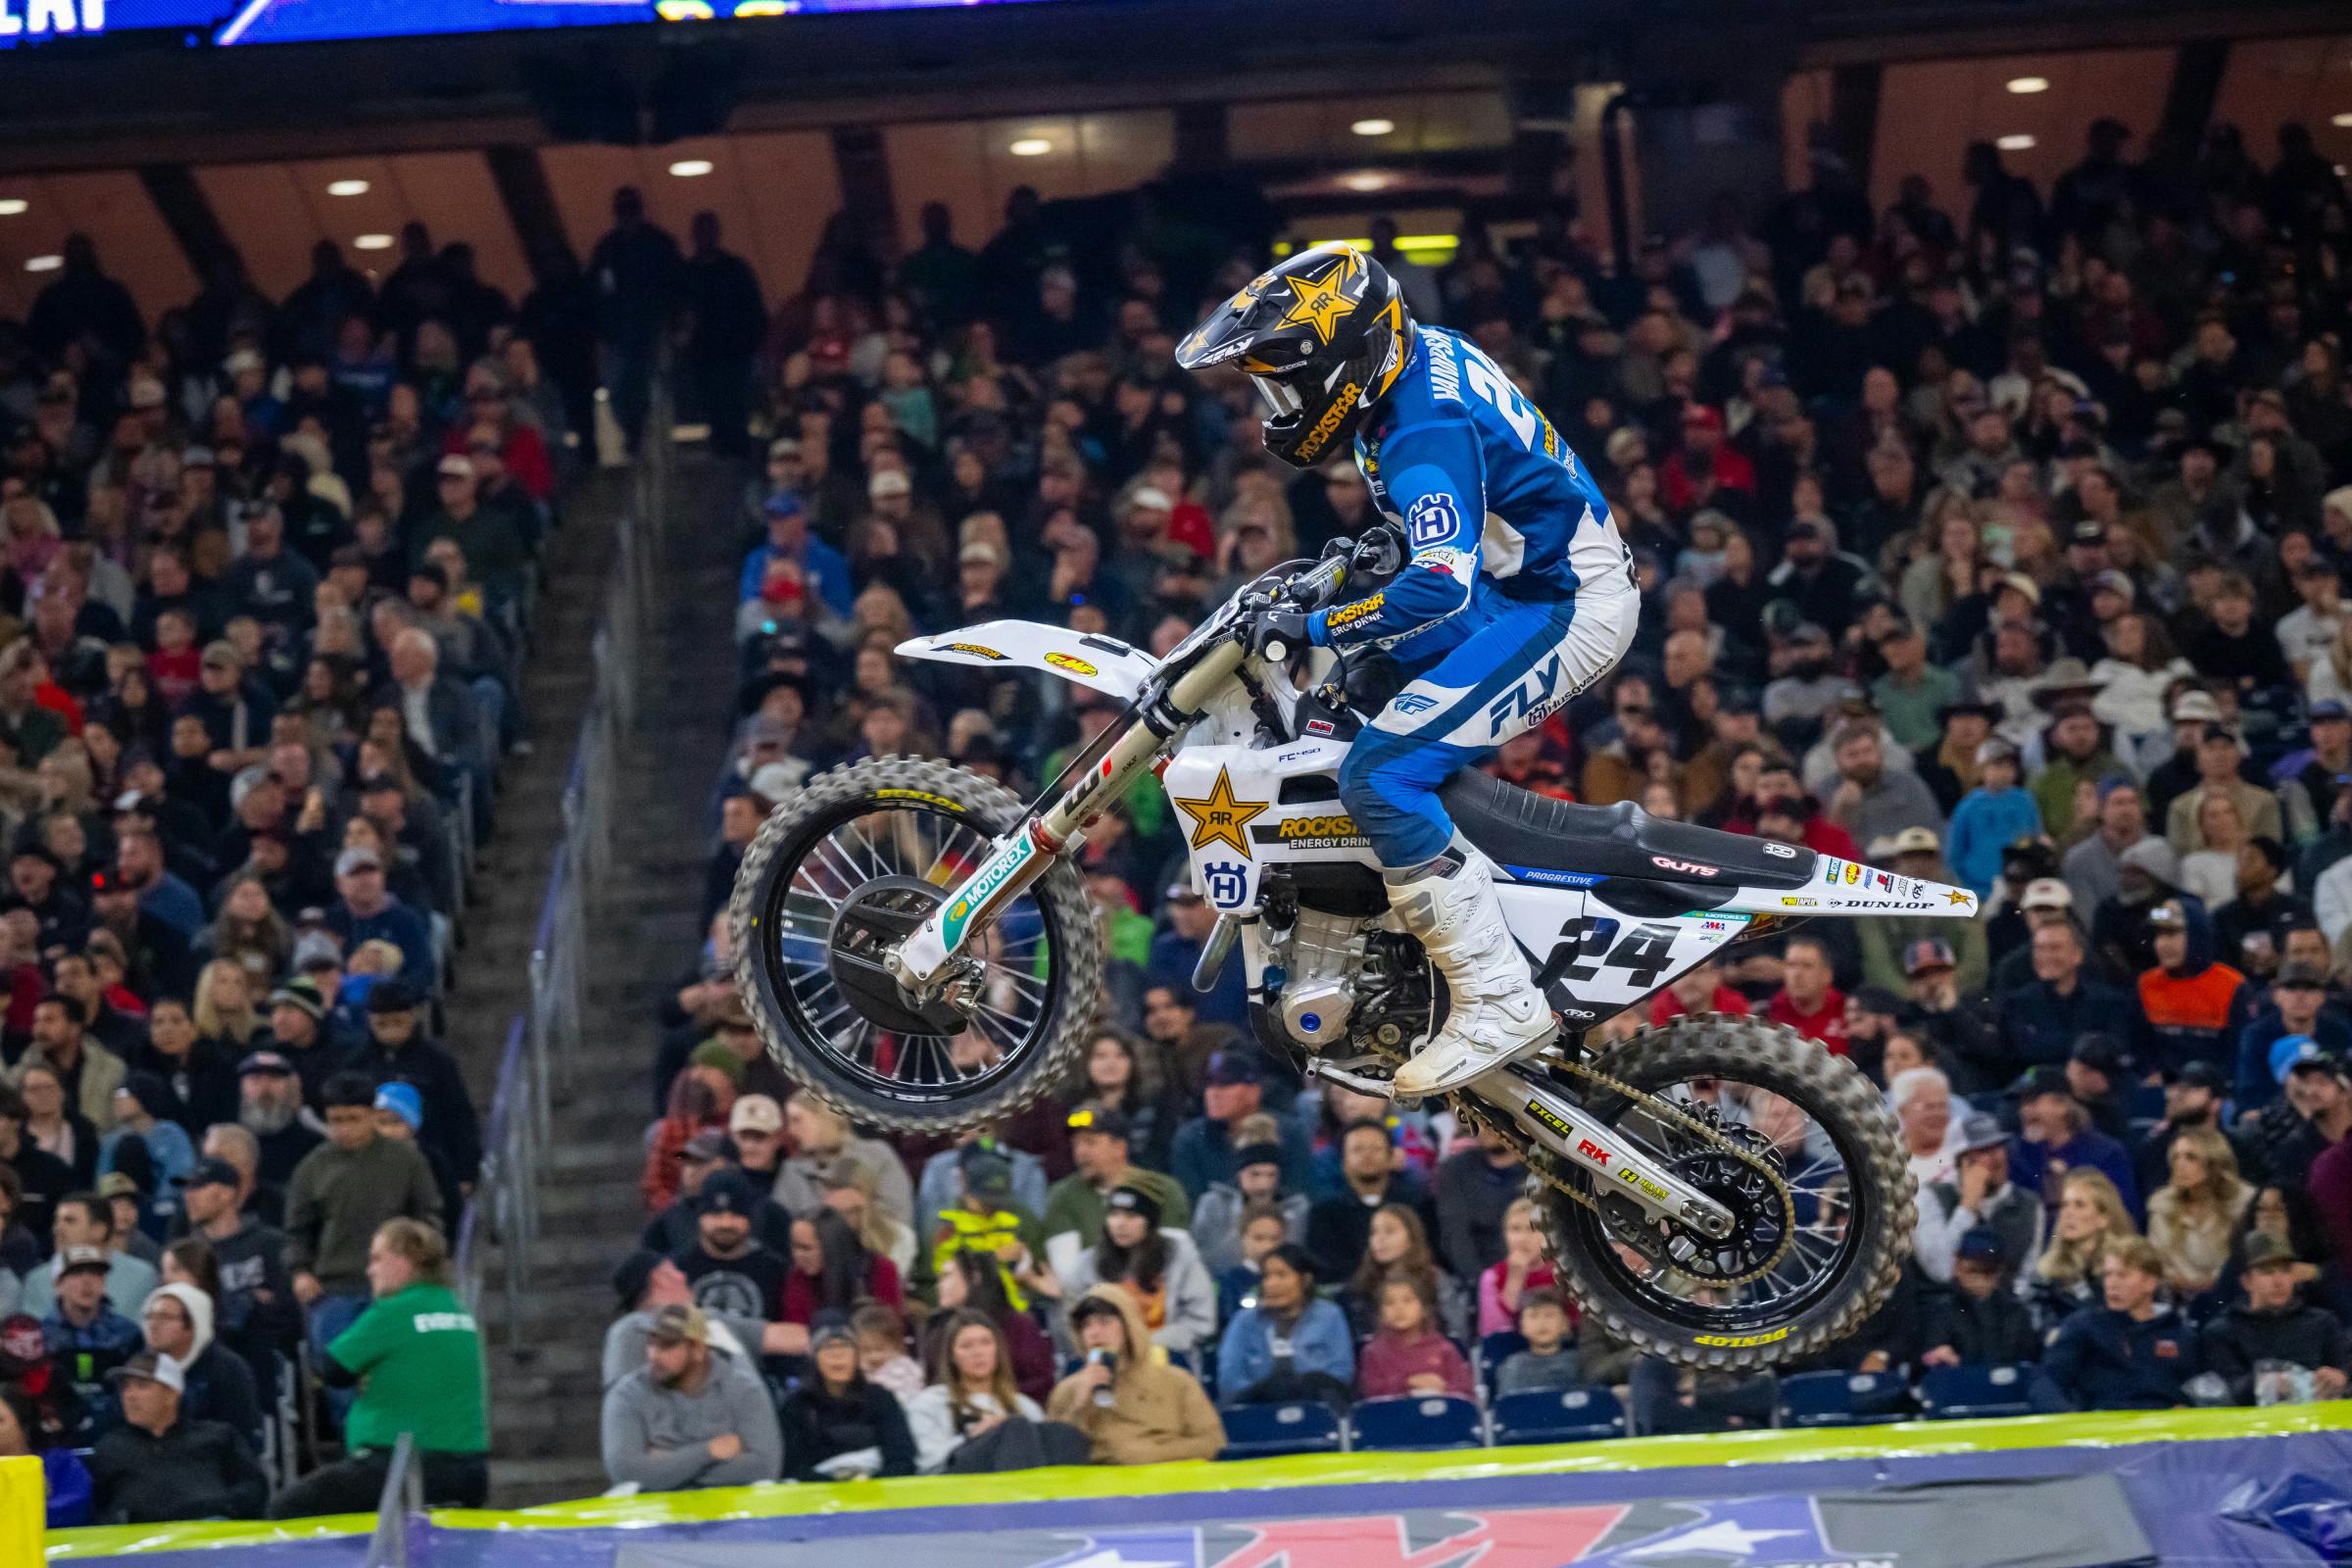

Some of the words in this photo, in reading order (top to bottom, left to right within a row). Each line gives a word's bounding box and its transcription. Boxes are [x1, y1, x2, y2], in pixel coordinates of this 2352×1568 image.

[1294, 382, 1362, 463] ROCKSTAR
[1353, 611, 1384, 629] DRINK
[1490, 654, 1560, 739] FLY
[1290, 838, 1339, 849] ENERGY
[1340, 836, 1372, 847] DRIN
[964, 842, 1028, 906] MOTOREX
[1525, 870, 1594, 885] PROGRESSIVE
[1652, 856, 1720, 877] GUTS
[1845, 900, 1935, 909] DUNLOP
[1533, 914, 1682, 989] 24
[1528, 1102, 1570, 1135] EXCEL
[1578, 1139, 1613, 1166] RK
[1693, 1326, 1788, 1348] DUNLOP
